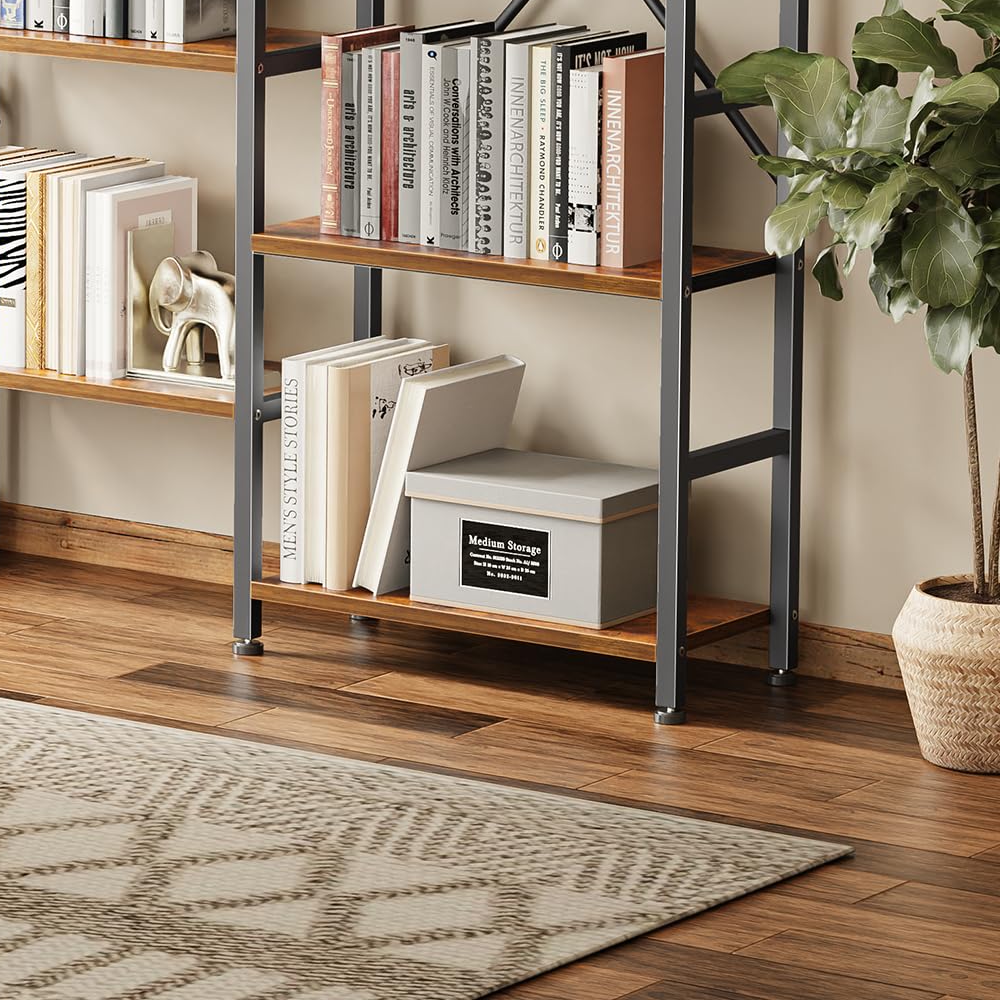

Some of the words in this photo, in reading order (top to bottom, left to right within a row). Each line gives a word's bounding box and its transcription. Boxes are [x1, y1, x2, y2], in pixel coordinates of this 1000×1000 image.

[442, 78, 450, 97] John
[539, 60, 547, 77] THE
[539, 80, 547, 94] BIG
[344, 102, 357, 120] arts
[403, 89, 417, 109] arts
[450, 78, 462, 145] Conversations
[539, 98, 547, 122] SLEEP
[442, 129, 450, 143] and
[344, 134, 357, 190] architecture
[403, 127, 417, 189] architecture
[442, 145, 450, 175] Heinrich
[450, 147, 462, 166] with
[509, 76, 524, 244] INNENARCHITEKTUR
[538, 134, 546, 180] RAYMOND
[606, 89, 623, 253] INNENARCHITEKTUR
[442, 177, 450, 195] Klotz
[450, 168, 462, 215] Architects
[538, 184, 546, 230] CHANDLER
[282, 377, 298, 449] STORIES
[282, 453, 298, 505] STYLE
[282, 509, 298, 561] MEN'S
[468, 534, 505, 549] Medium
[507, 540, 541, 557] Storage
